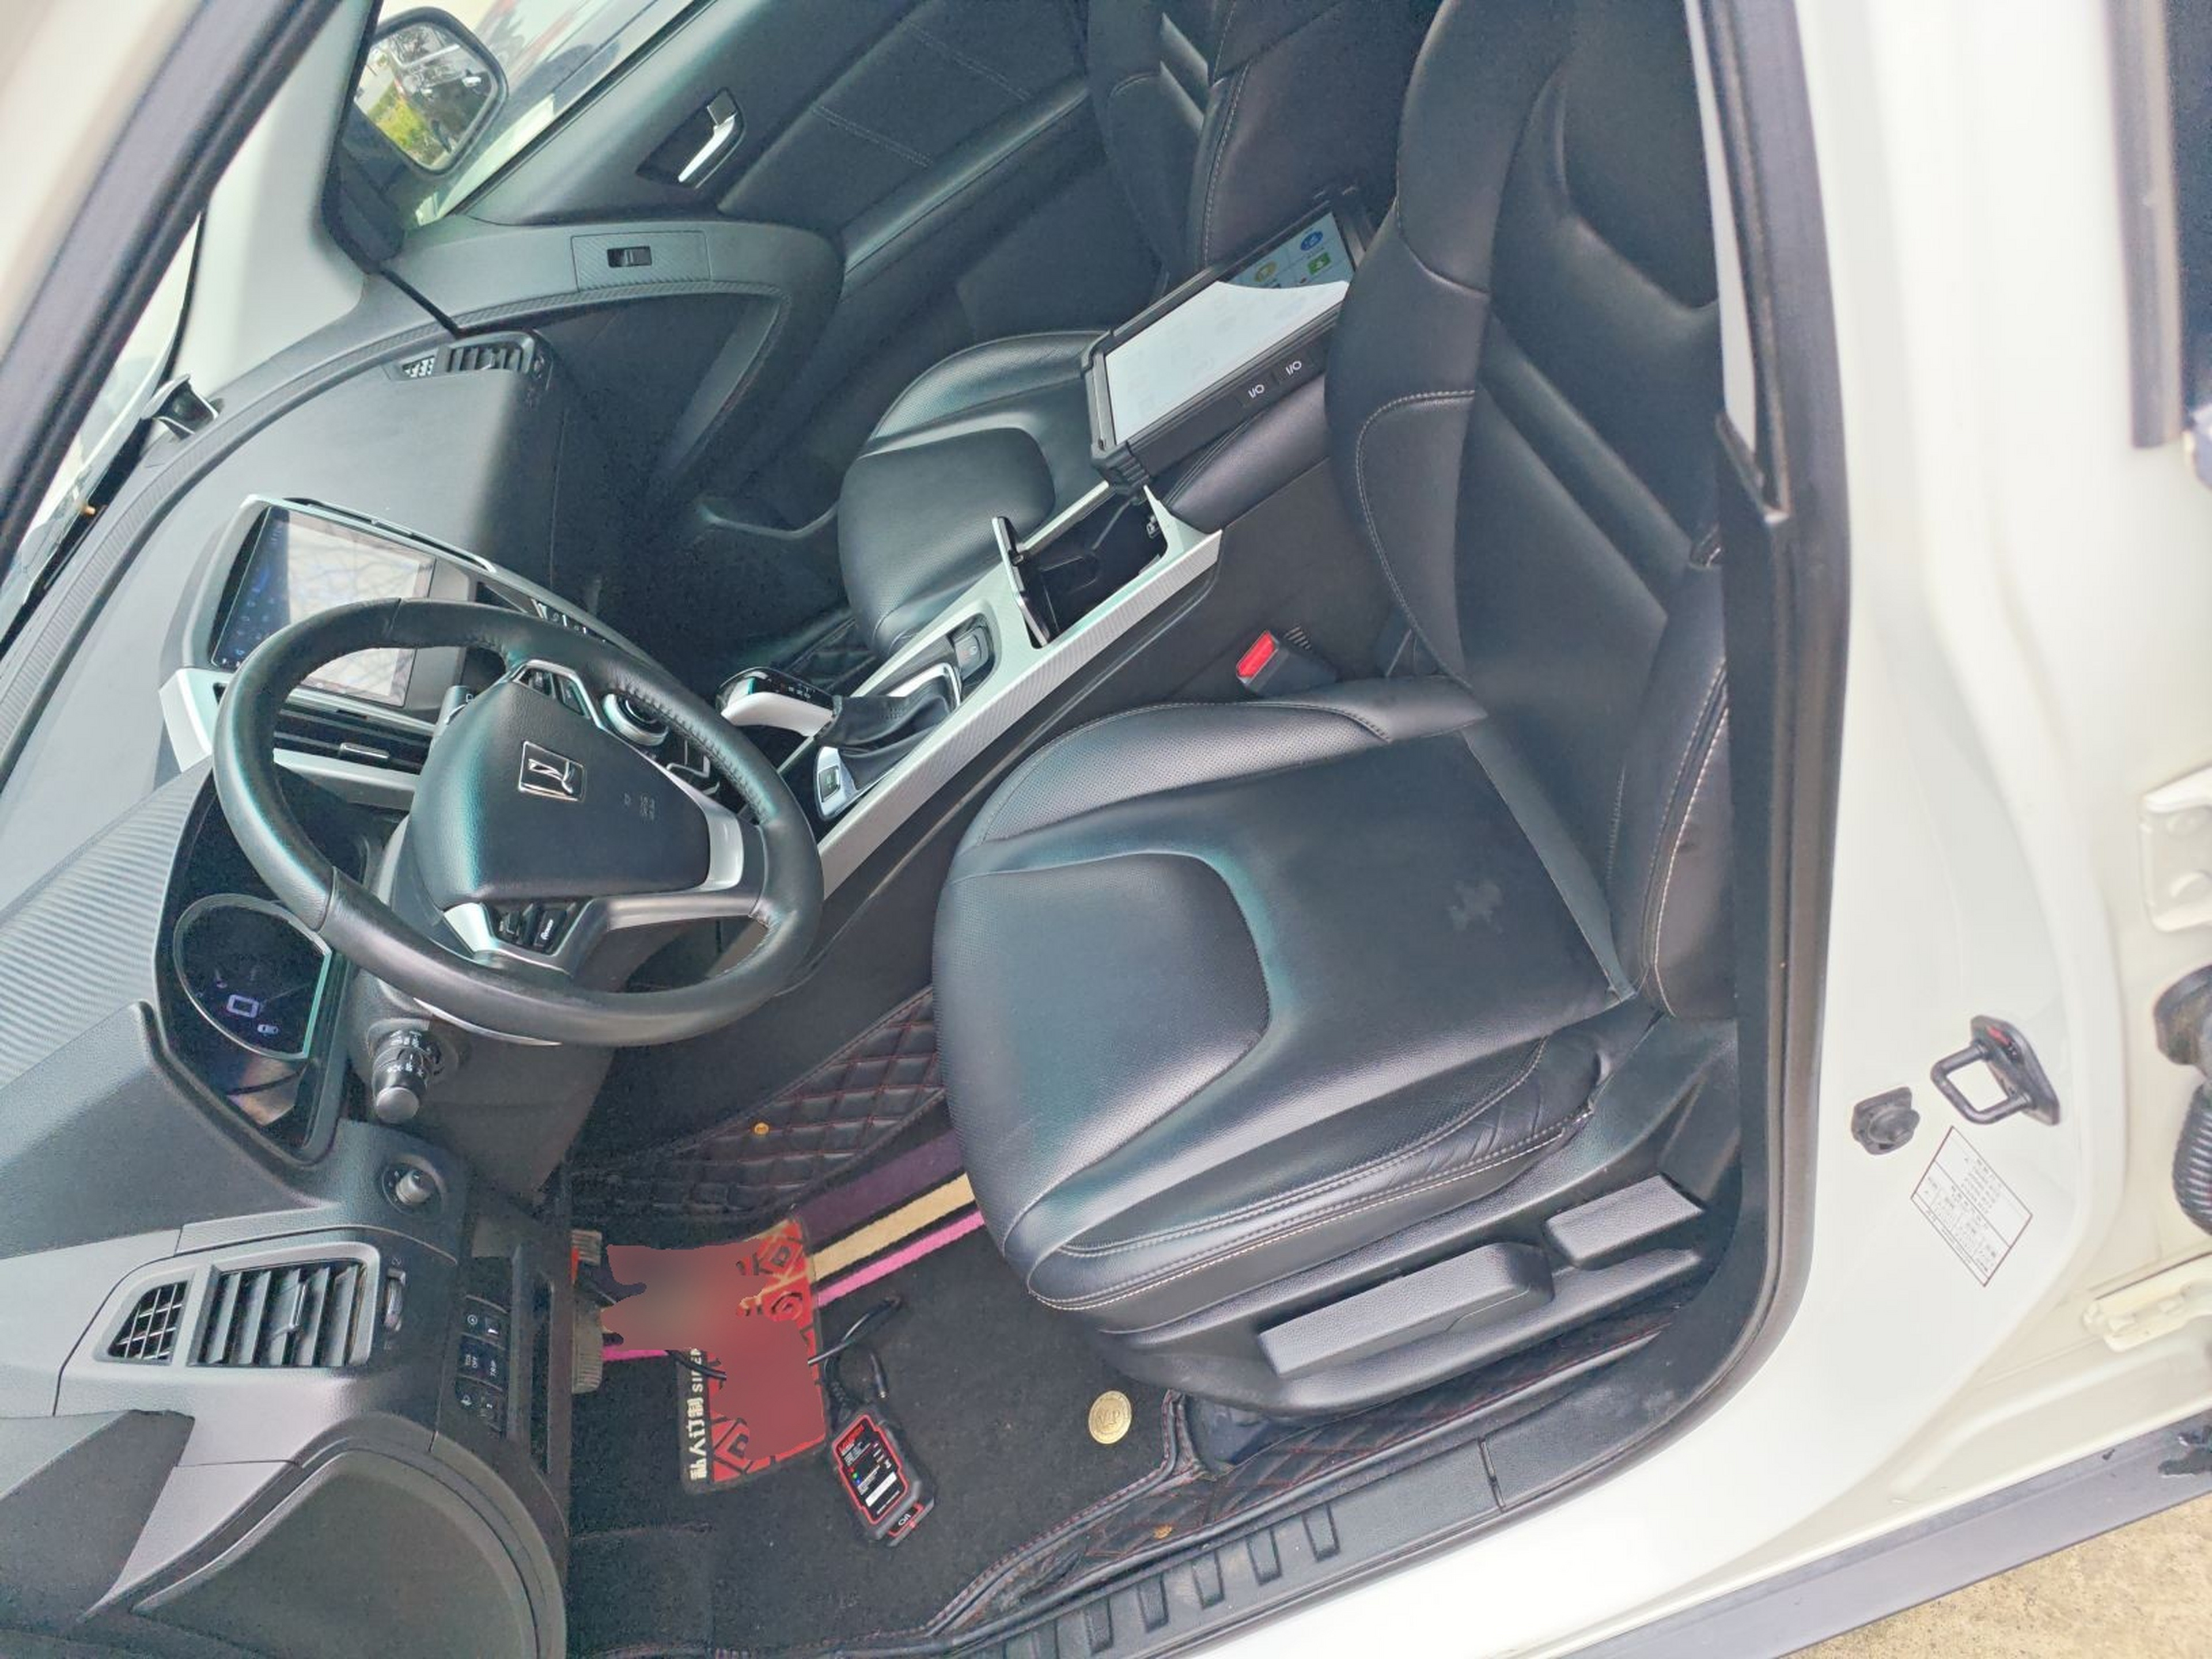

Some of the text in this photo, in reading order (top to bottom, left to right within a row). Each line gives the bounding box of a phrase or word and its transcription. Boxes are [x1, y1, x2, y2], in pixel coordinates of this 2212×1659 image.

[1286, 361, 1302, 376] I/O
[1248, 384, 1264, 399] I/O
[687, 1397, 707, 1480] 私人订制
